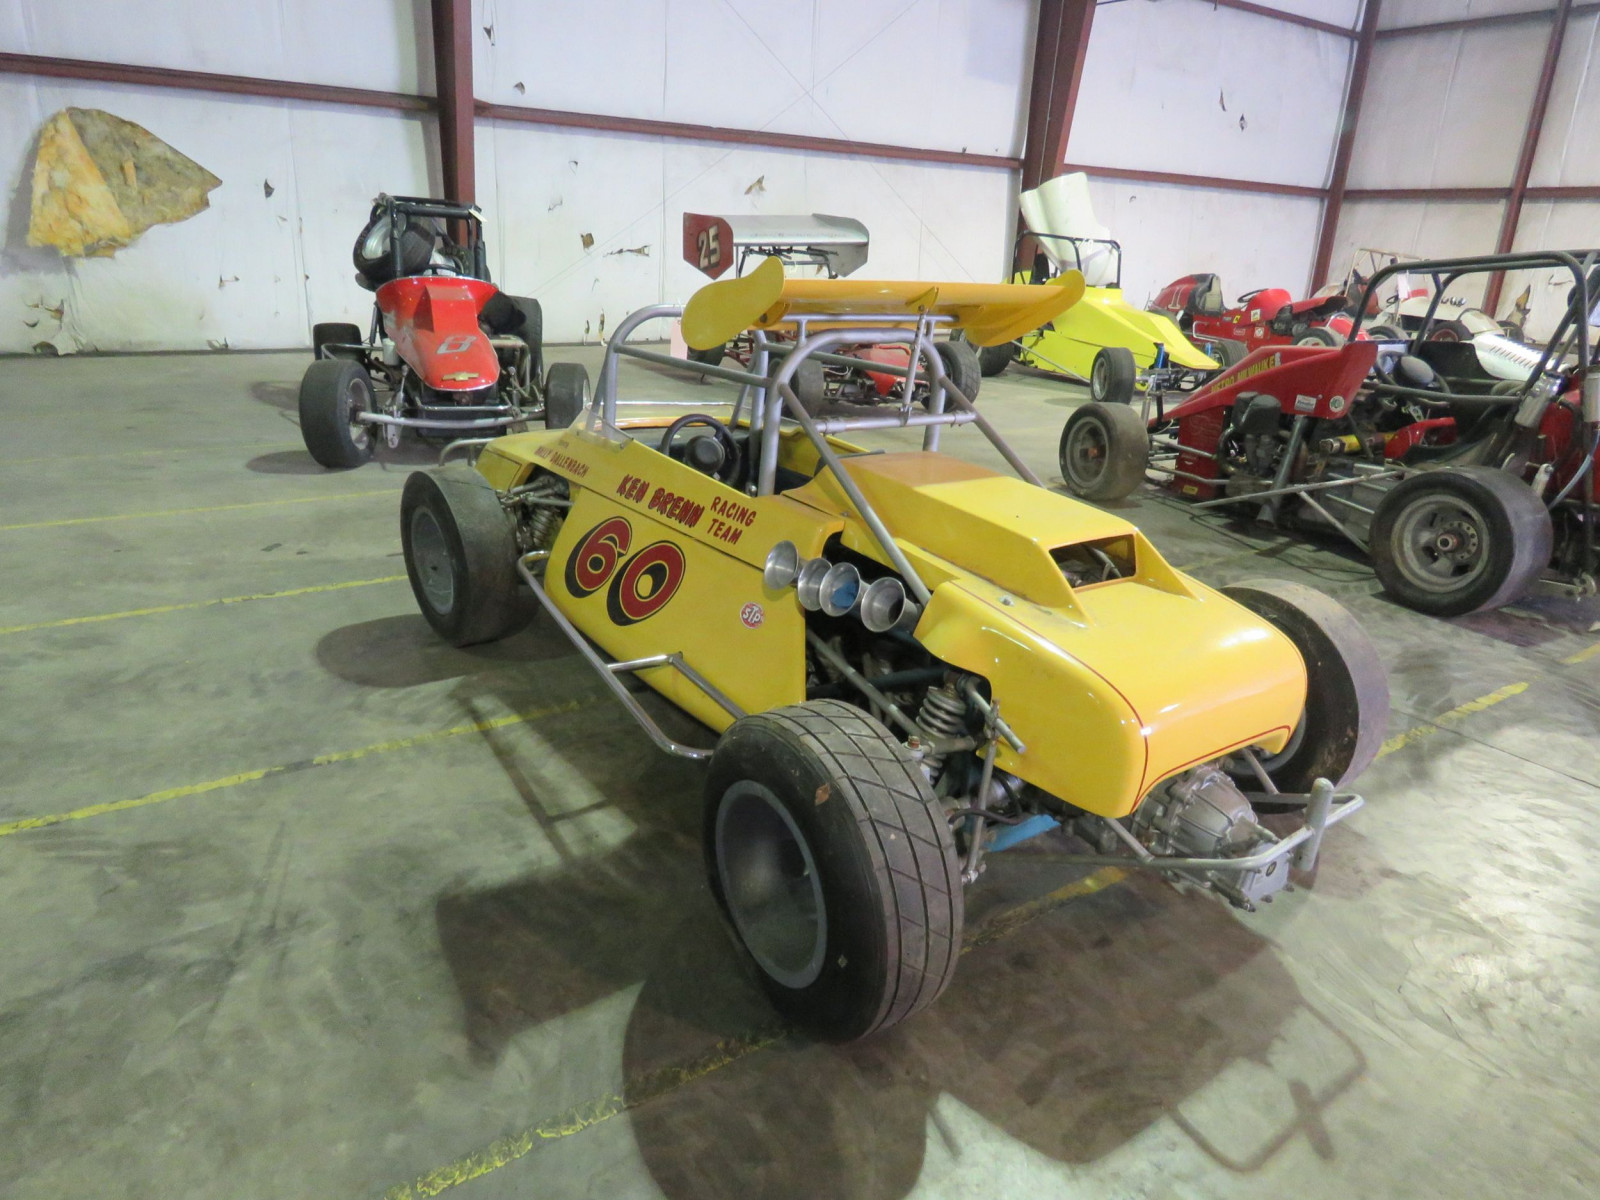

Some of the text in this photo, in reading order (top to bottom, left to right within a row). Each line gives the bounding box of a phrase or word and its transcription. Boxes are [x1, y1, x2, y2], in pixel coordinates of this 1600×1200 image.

[697, 224, 721, 269] 25
[616, 473, 705, 528] KEN BRENN
[710, 496, 757, 527] RACING
[706, 518, 743, 545] TEAM
[564, 515, 686, 626] 60
[742, 605, 761, 624] STP
